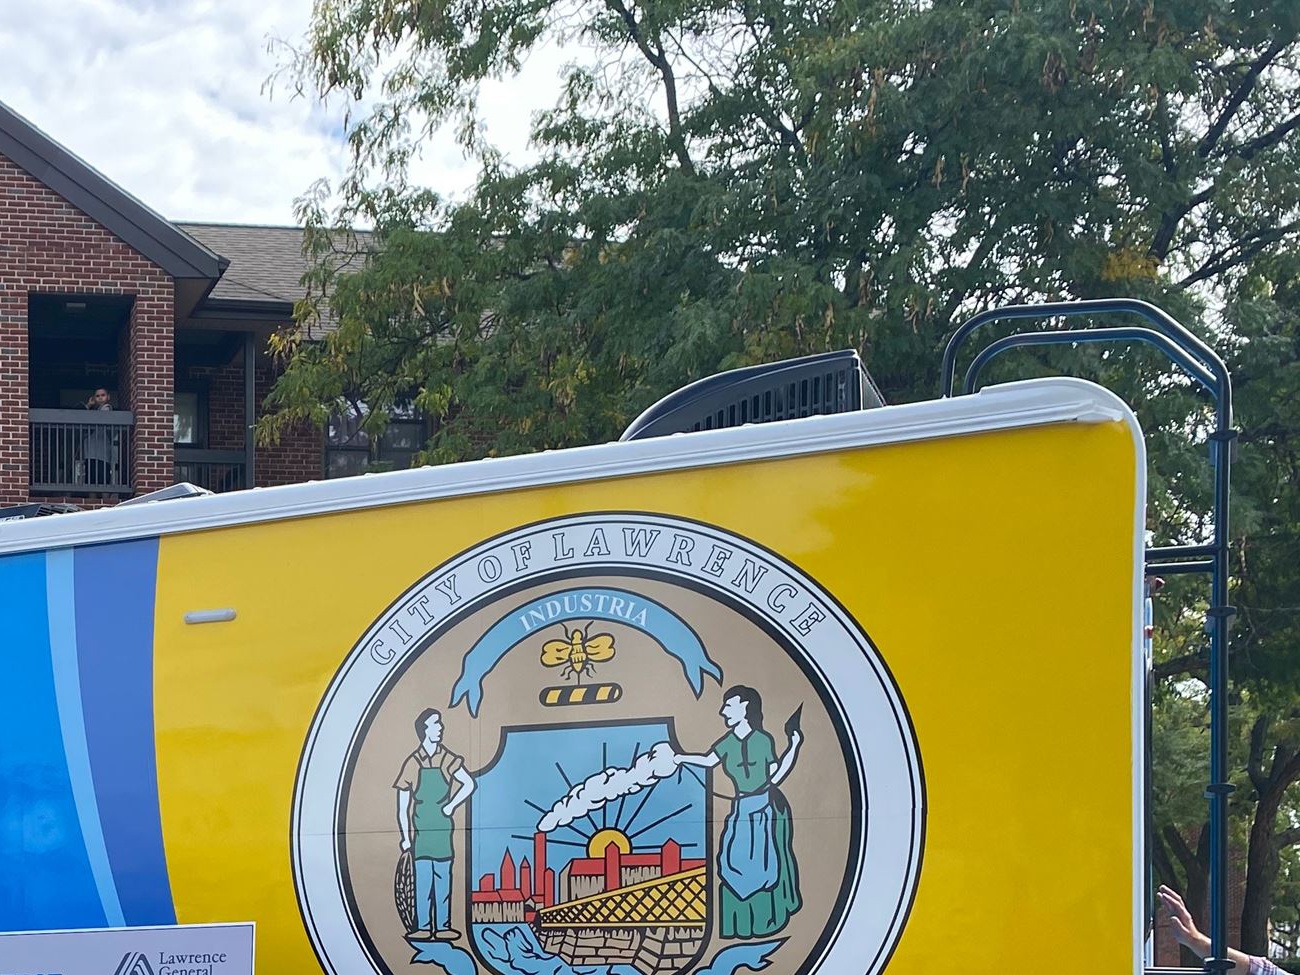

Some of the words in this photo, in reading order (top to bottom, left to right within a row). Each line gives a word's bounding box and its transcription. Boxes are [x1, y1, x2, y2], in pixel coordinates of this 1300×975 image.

[370, 574, 462, 666] CITY
[477, 540, 532, 584] OF
[552, 526, 826, 638] LAWRENCE
[518, 593, 649, 633] INDUSTRIA
[159, 951, 227, 965] Lawrence
